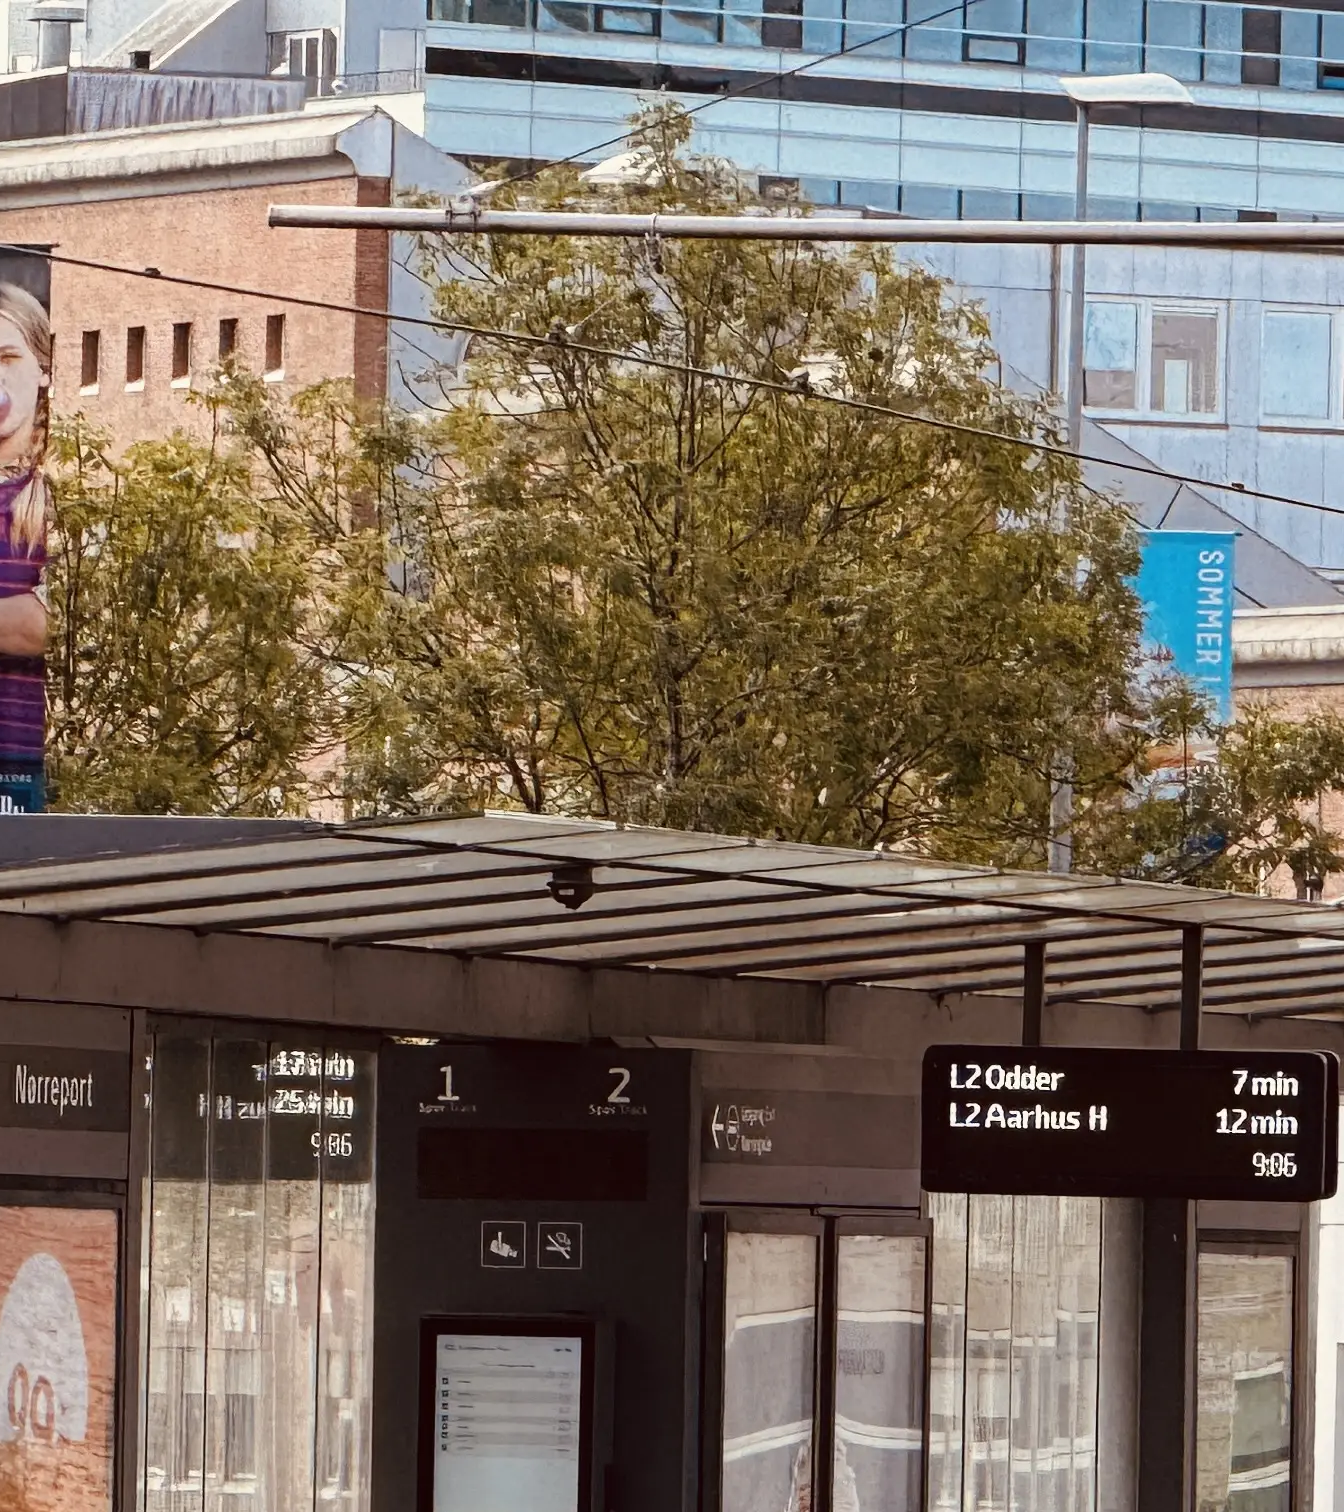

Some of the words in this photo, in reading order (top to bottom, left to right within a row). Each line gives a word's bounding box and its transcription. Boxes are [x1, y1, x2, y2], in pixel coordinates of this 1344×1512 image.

[1196, 550, 1225, 664] SOMMER
[15, 1064, 93, 1116] Nørreport
[437, 1065, 460, 1101] 1
[607, 1067, 631, 1103] 2
[950, 1063, 981, 1090] L2
[985, 1064, 1066, 1091] Odder
[1232, 1070, 1248, 1096] 7
[1251, 1071, 1299, 1097] min
[949, 1102, 981, 1129] L2
[985, 1103, 1081, 1131] Aarhus
[1089, 1105, 1108, 1132] H
[1216, 1109, 1247, 1135] 12
[1250, 1109, 1299, 1135] min
[1252, 1153, 1298, 1178] 9:06
